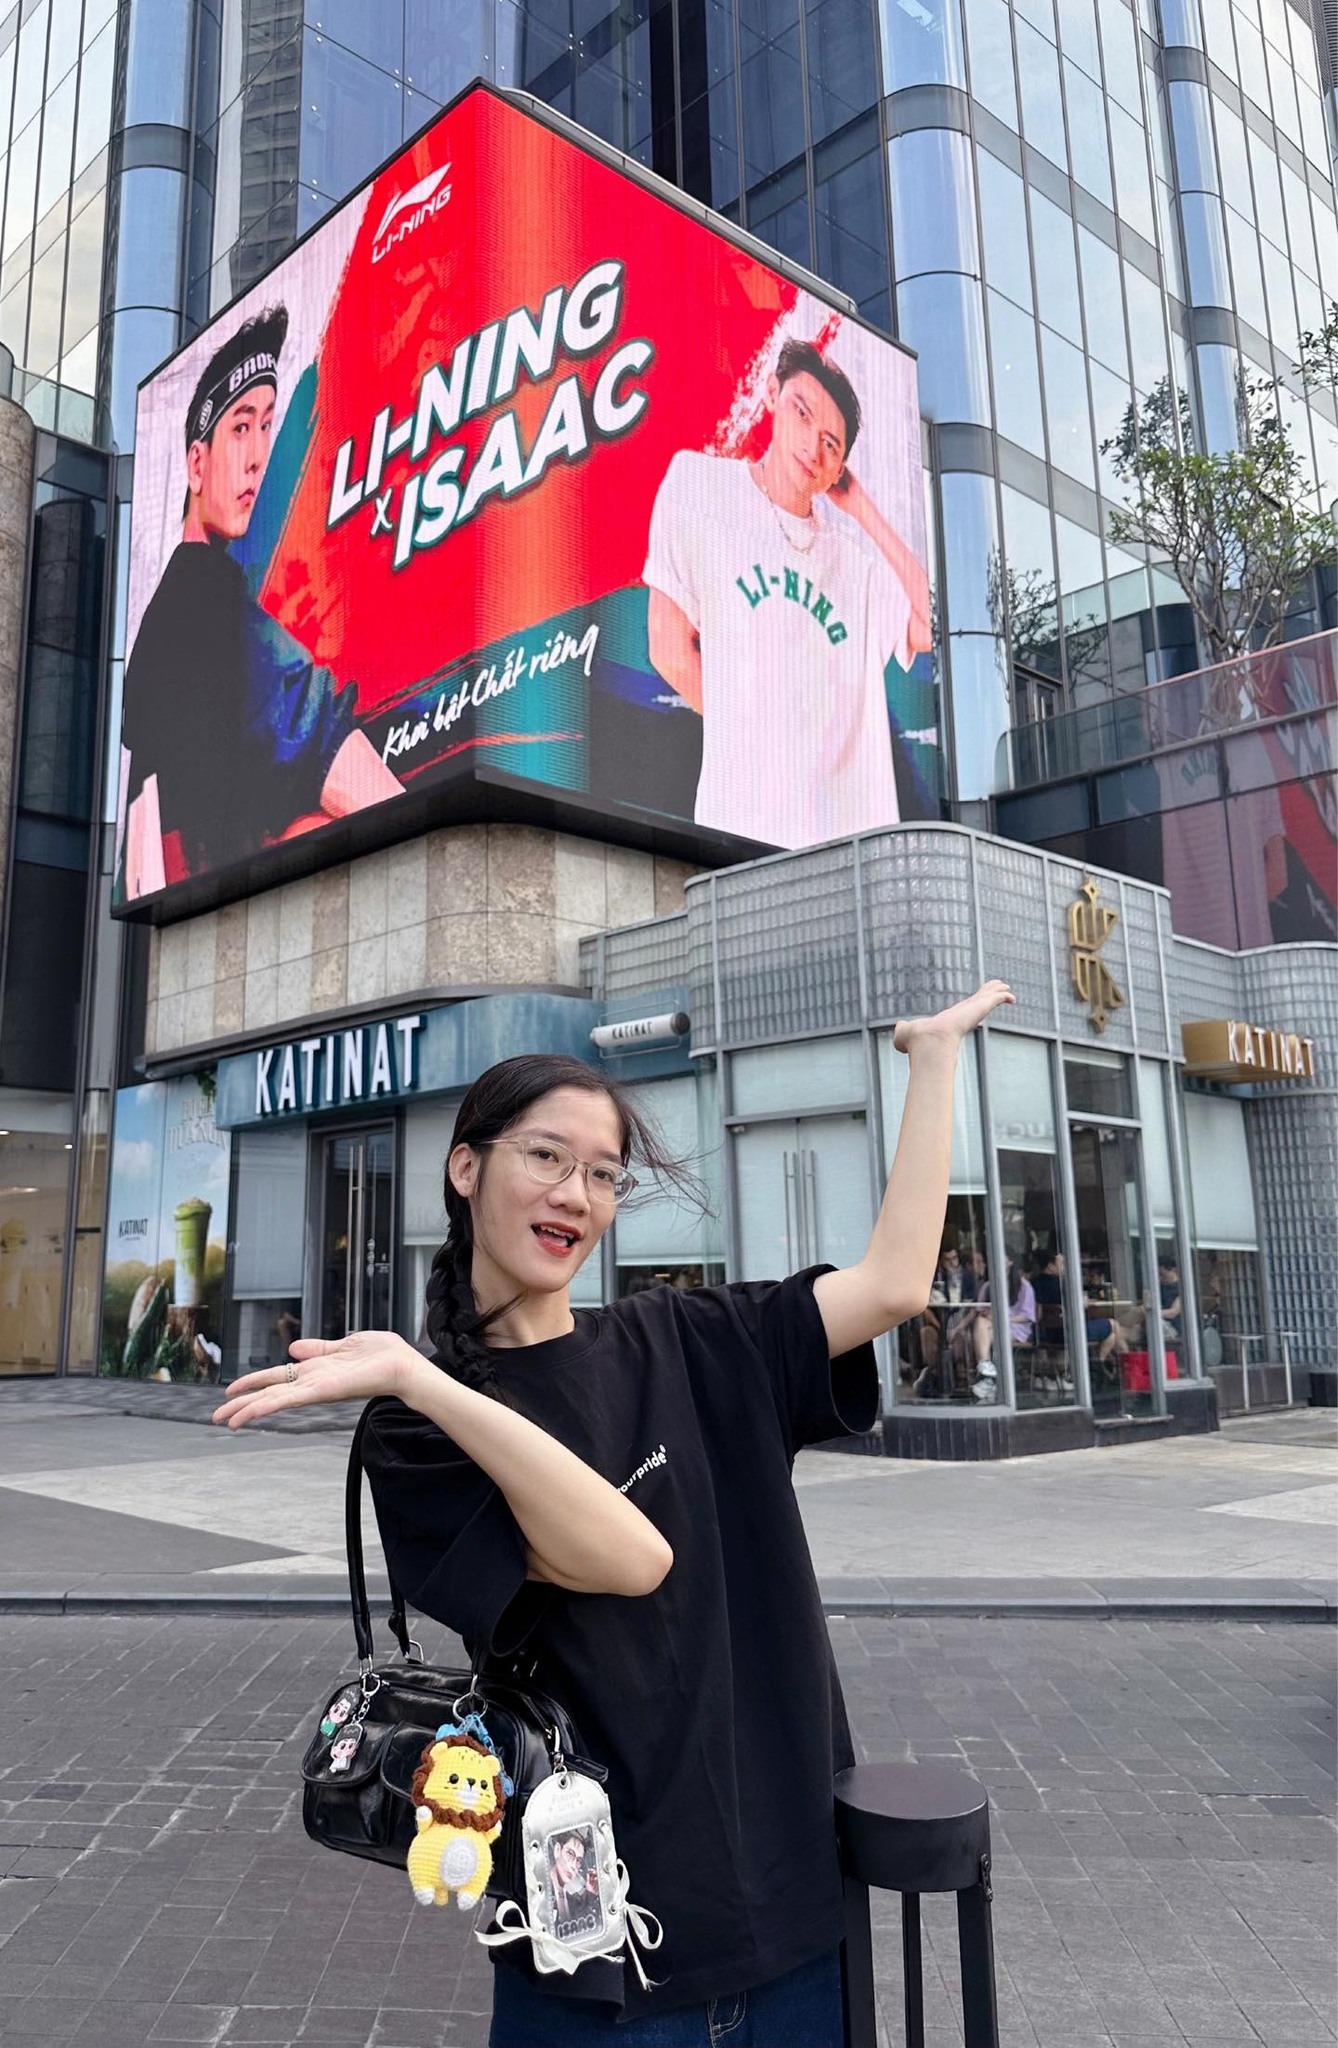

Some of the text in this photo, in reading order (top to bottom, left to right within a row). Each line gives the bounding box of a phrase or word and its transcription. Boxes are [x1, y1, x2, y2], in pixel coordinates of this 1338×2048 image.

[371, 183, 453, 264] LI-NING
[327, 260, 624, 530] LI-NING
[393, 336, 653, 571] ISAAC
[735, 563, 849, 645] LI-NING
[433, 681, 471, 732] bật
[528, 624, 600, 677] riêng
[255, 1014, 425, 1115] KATINAT
[612, 1021, 653, 1039] KATINAT
[1227, 1020, 1314, 1077] KATINAT
[119, 1218, 148, 1238] KATINAT
[558, 1914, 596, 1939] ISAAC
